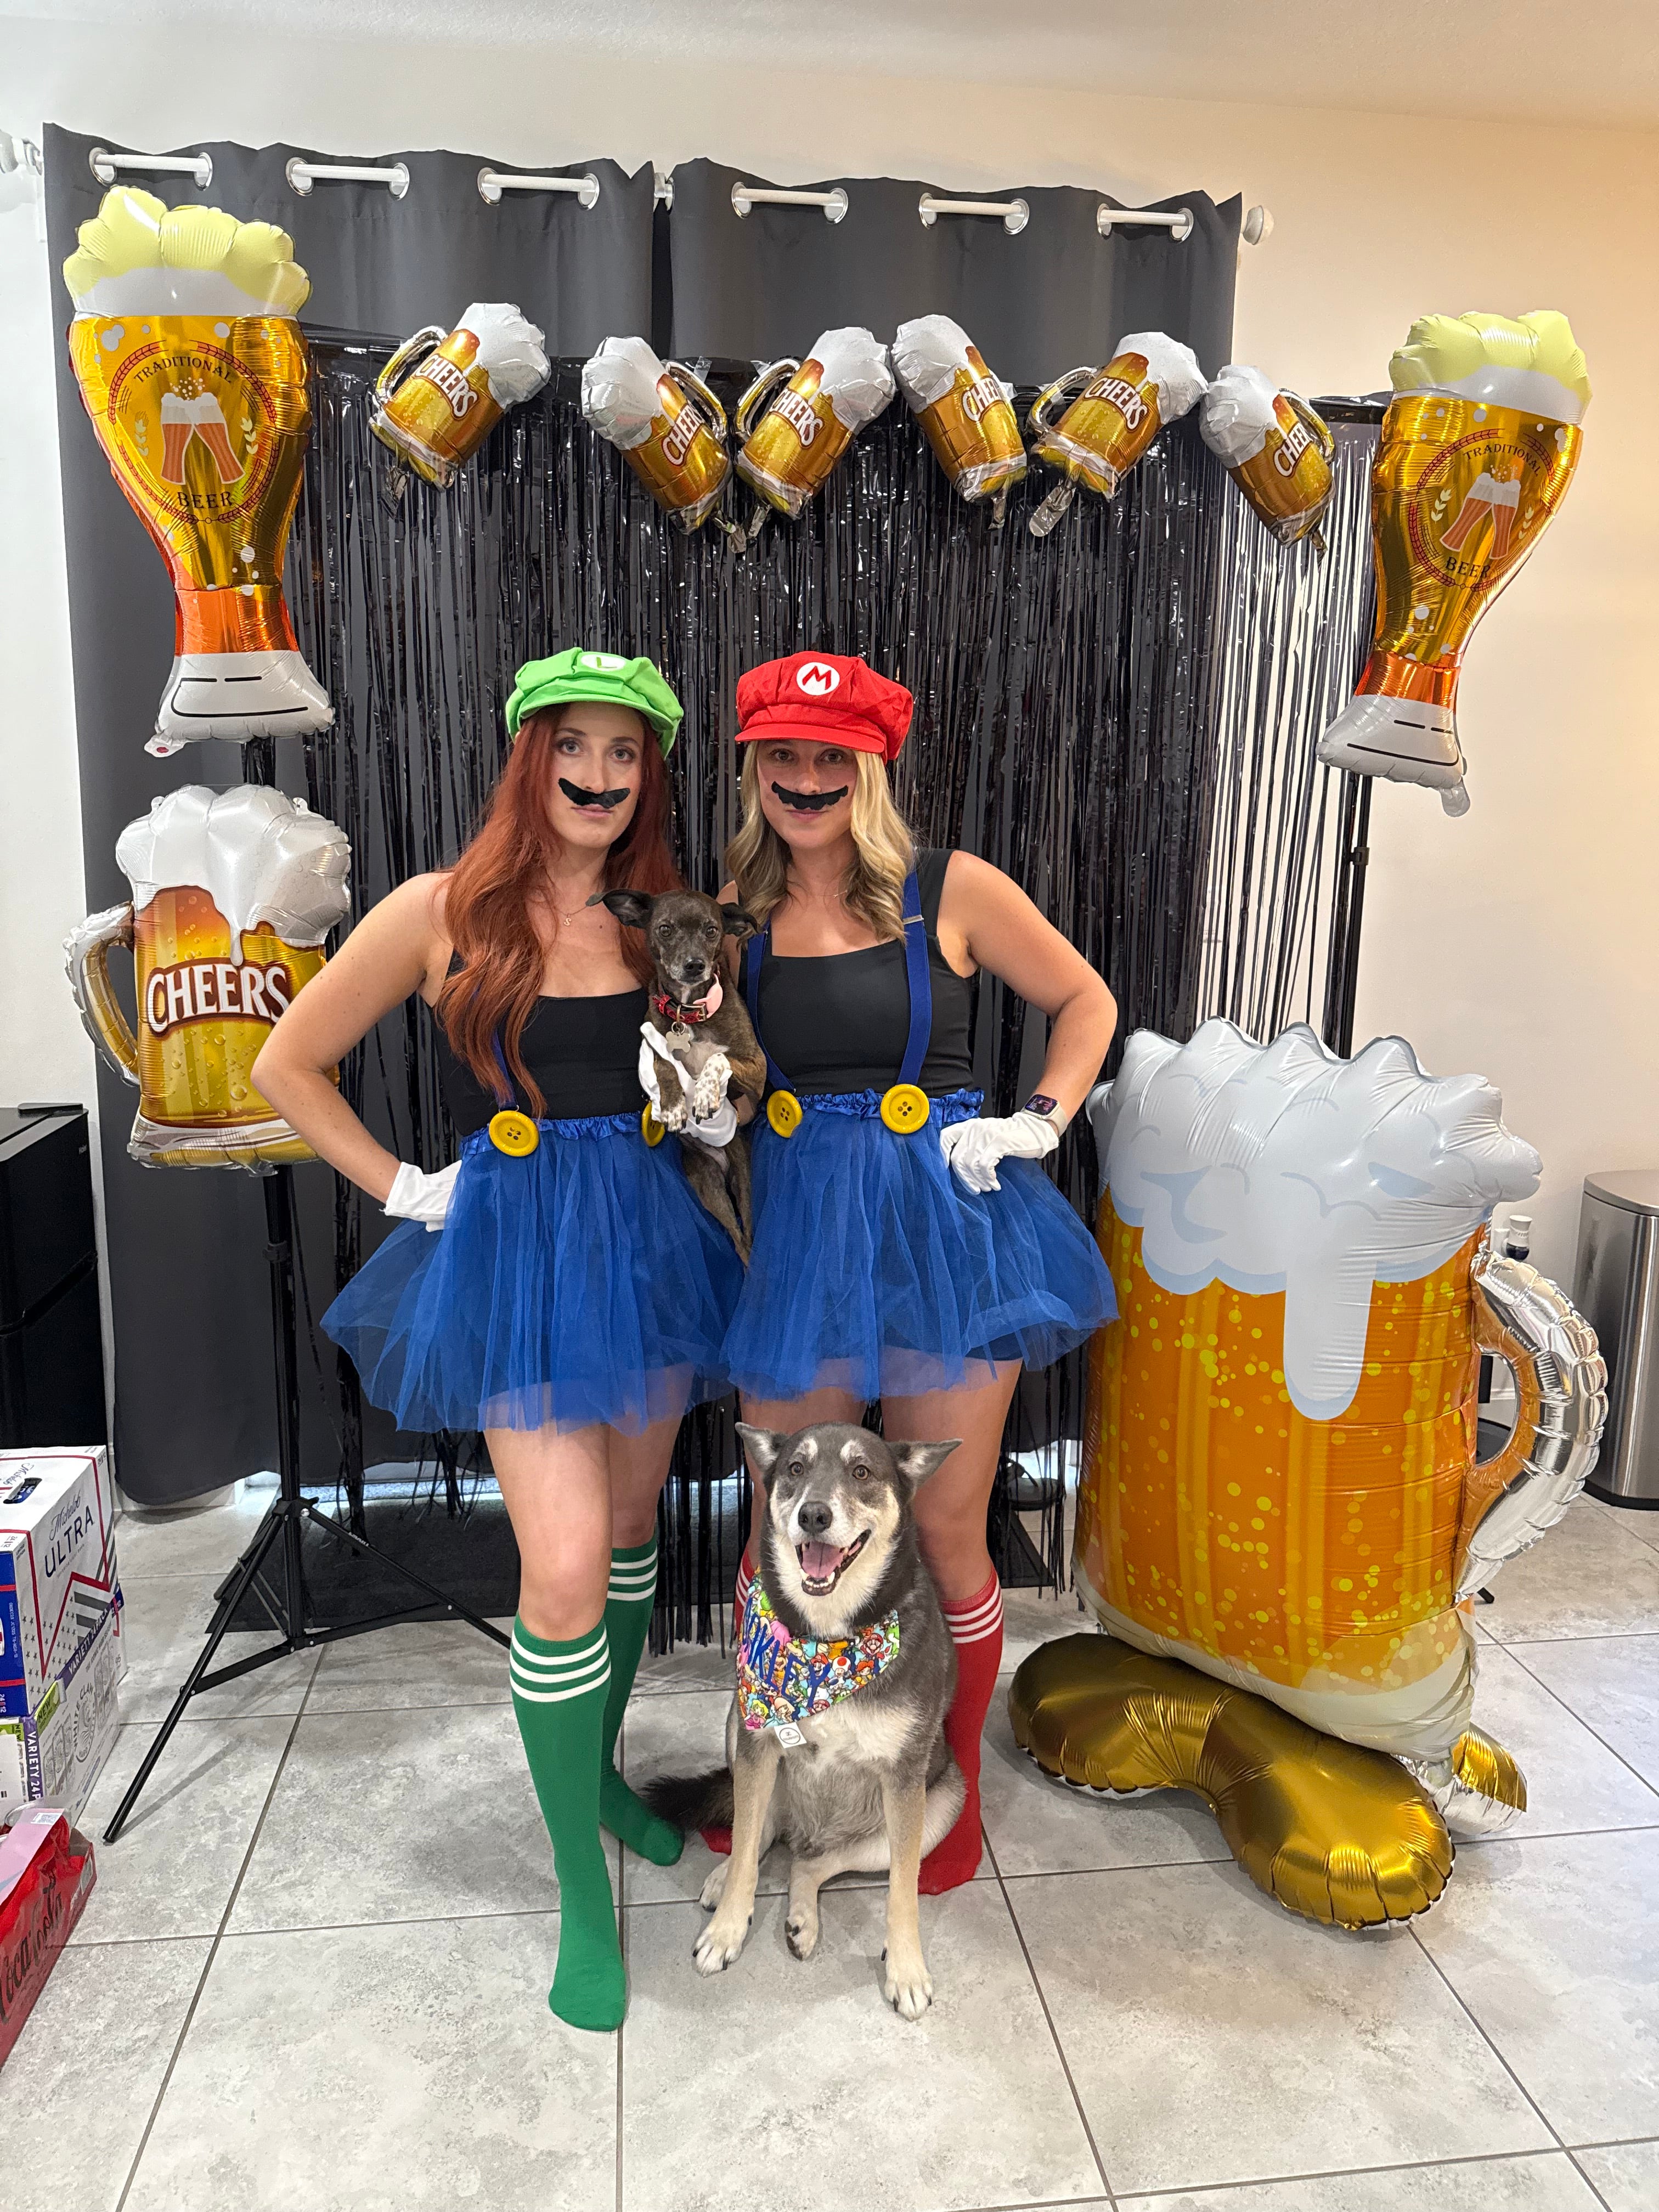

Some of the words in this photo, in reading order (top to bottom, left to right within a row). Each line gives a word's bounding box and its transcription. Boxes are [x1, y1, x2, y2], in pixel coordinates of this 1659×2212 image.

[133, 356, 233, 385] TRADITIONAL
[414, 354, 477, 417] CHEERS
[769, 388, 823, 446] CHEERS
[962, 377, 1002, 421] CHEE
[1084, 377, 1148, 430] CHEERS
[1462, 443, 1541, 477] TRADITIONAL
[177, 490, 234, 509] BEER
[1444, 556, 1492, 579] BEER
[596, 656, 618, 669] L
[802, 665, 832, 691] M
[148, 963, 290, 1032] CHEERS
[49, 1489, 81, 1541] Michelob
[44, 1504, 94, 1578] ULTRA
[27, 1731, 40, 1778] VARIETY
[30, 1780, 41, 1793] 24
